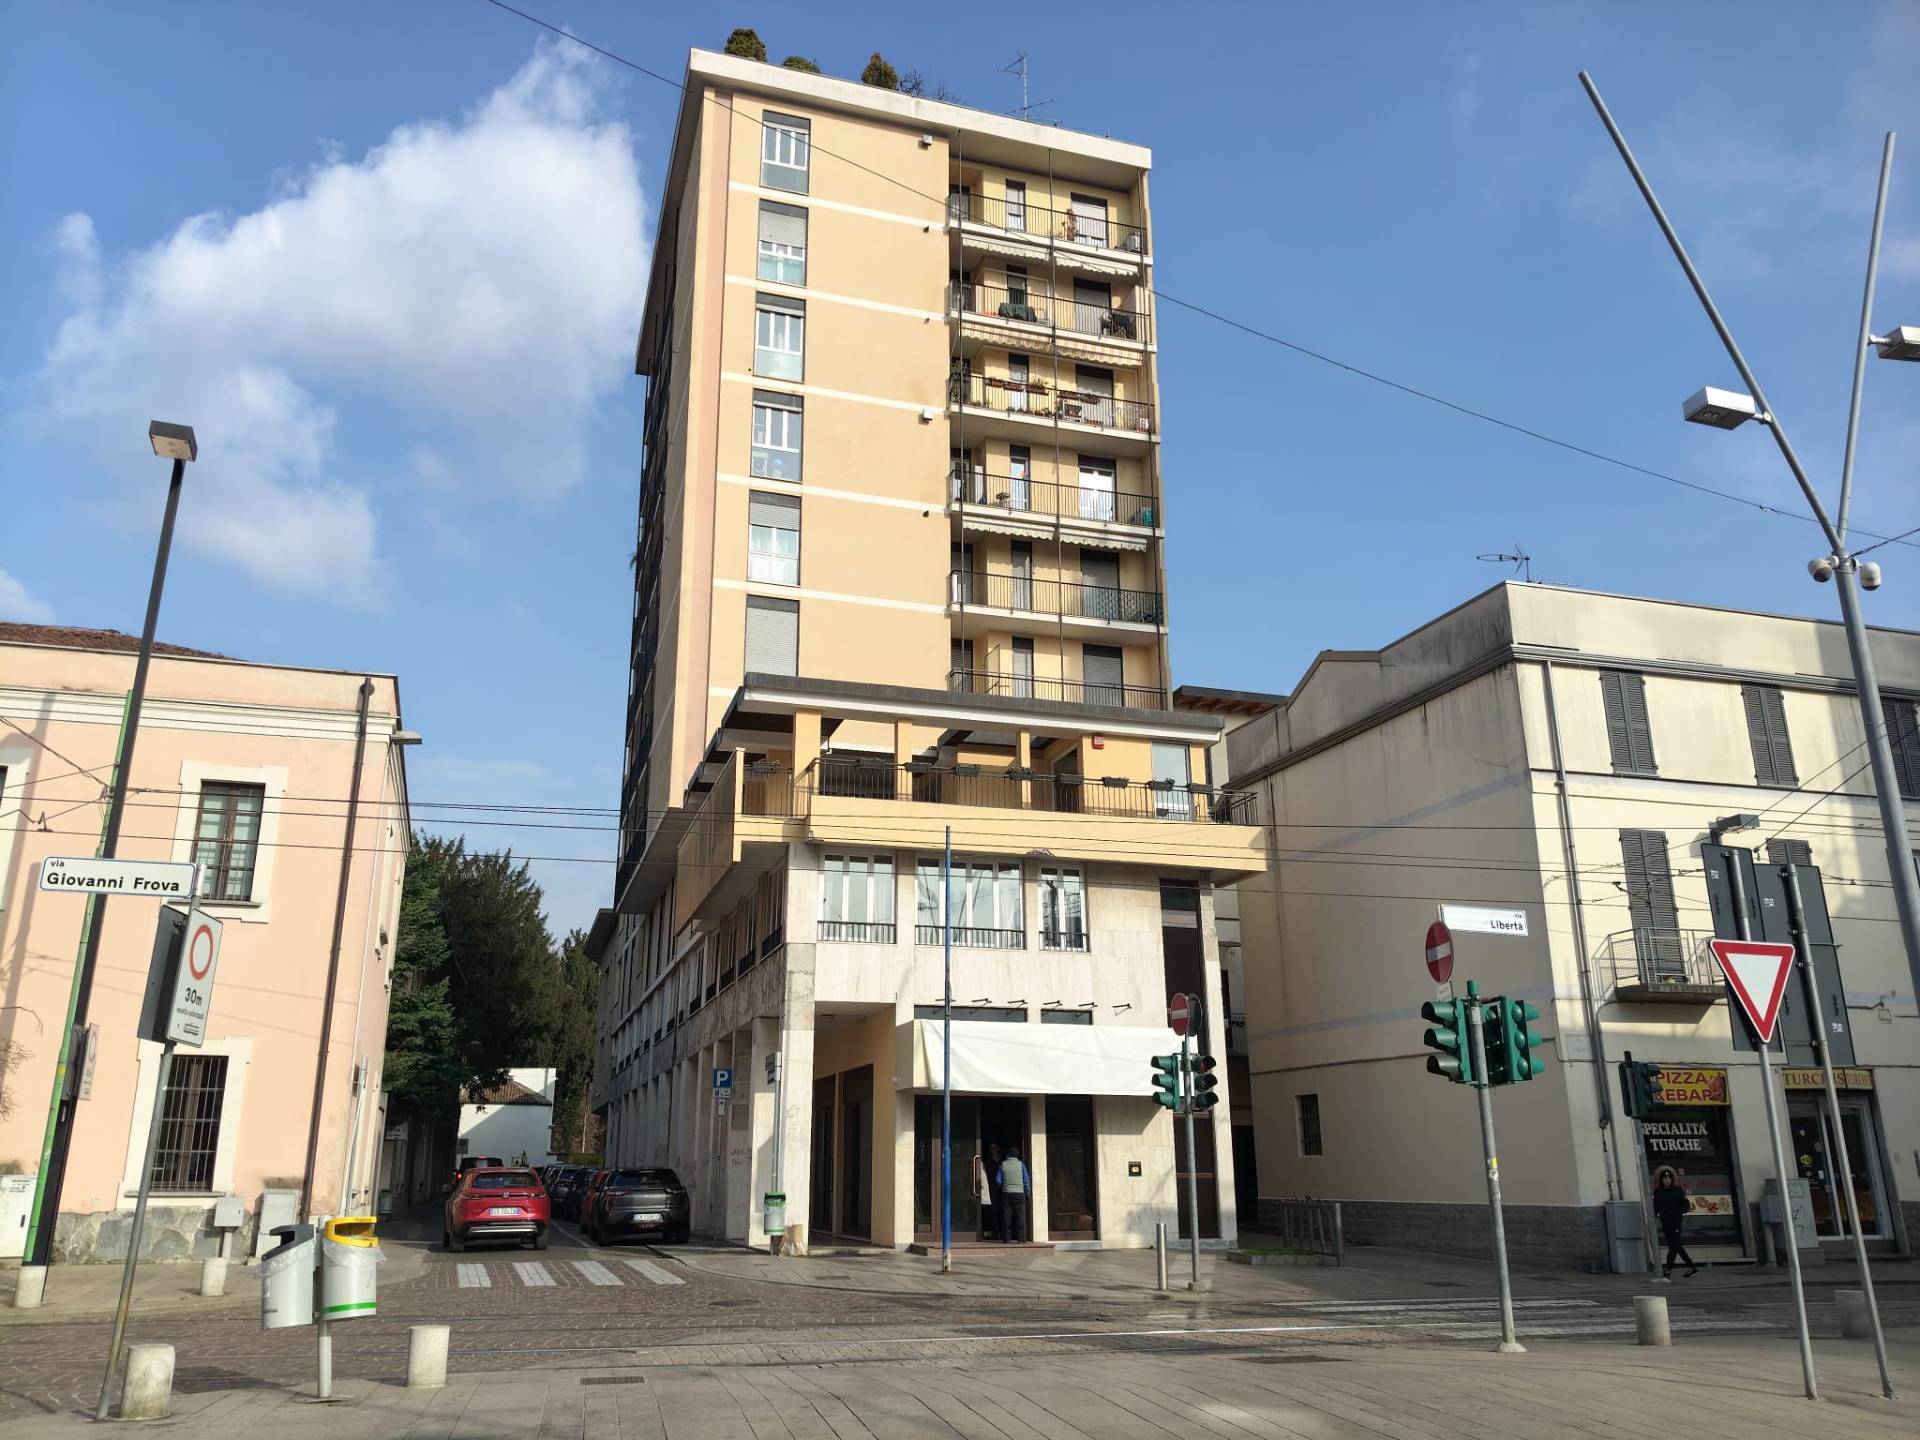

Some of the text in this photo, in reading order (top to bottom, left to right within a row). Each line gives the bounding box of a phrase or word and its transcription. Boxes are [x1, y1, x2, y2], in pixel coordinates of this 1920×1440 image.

[50, 859, 65, 867] via
[46, 872, 180, 892] Giovanni Frova
[716, 1070, 729, 1087] P
[1656, 1071, 1708, 1085] PIZZA
[1649, 1138, 1702, 1151] TURCHE
